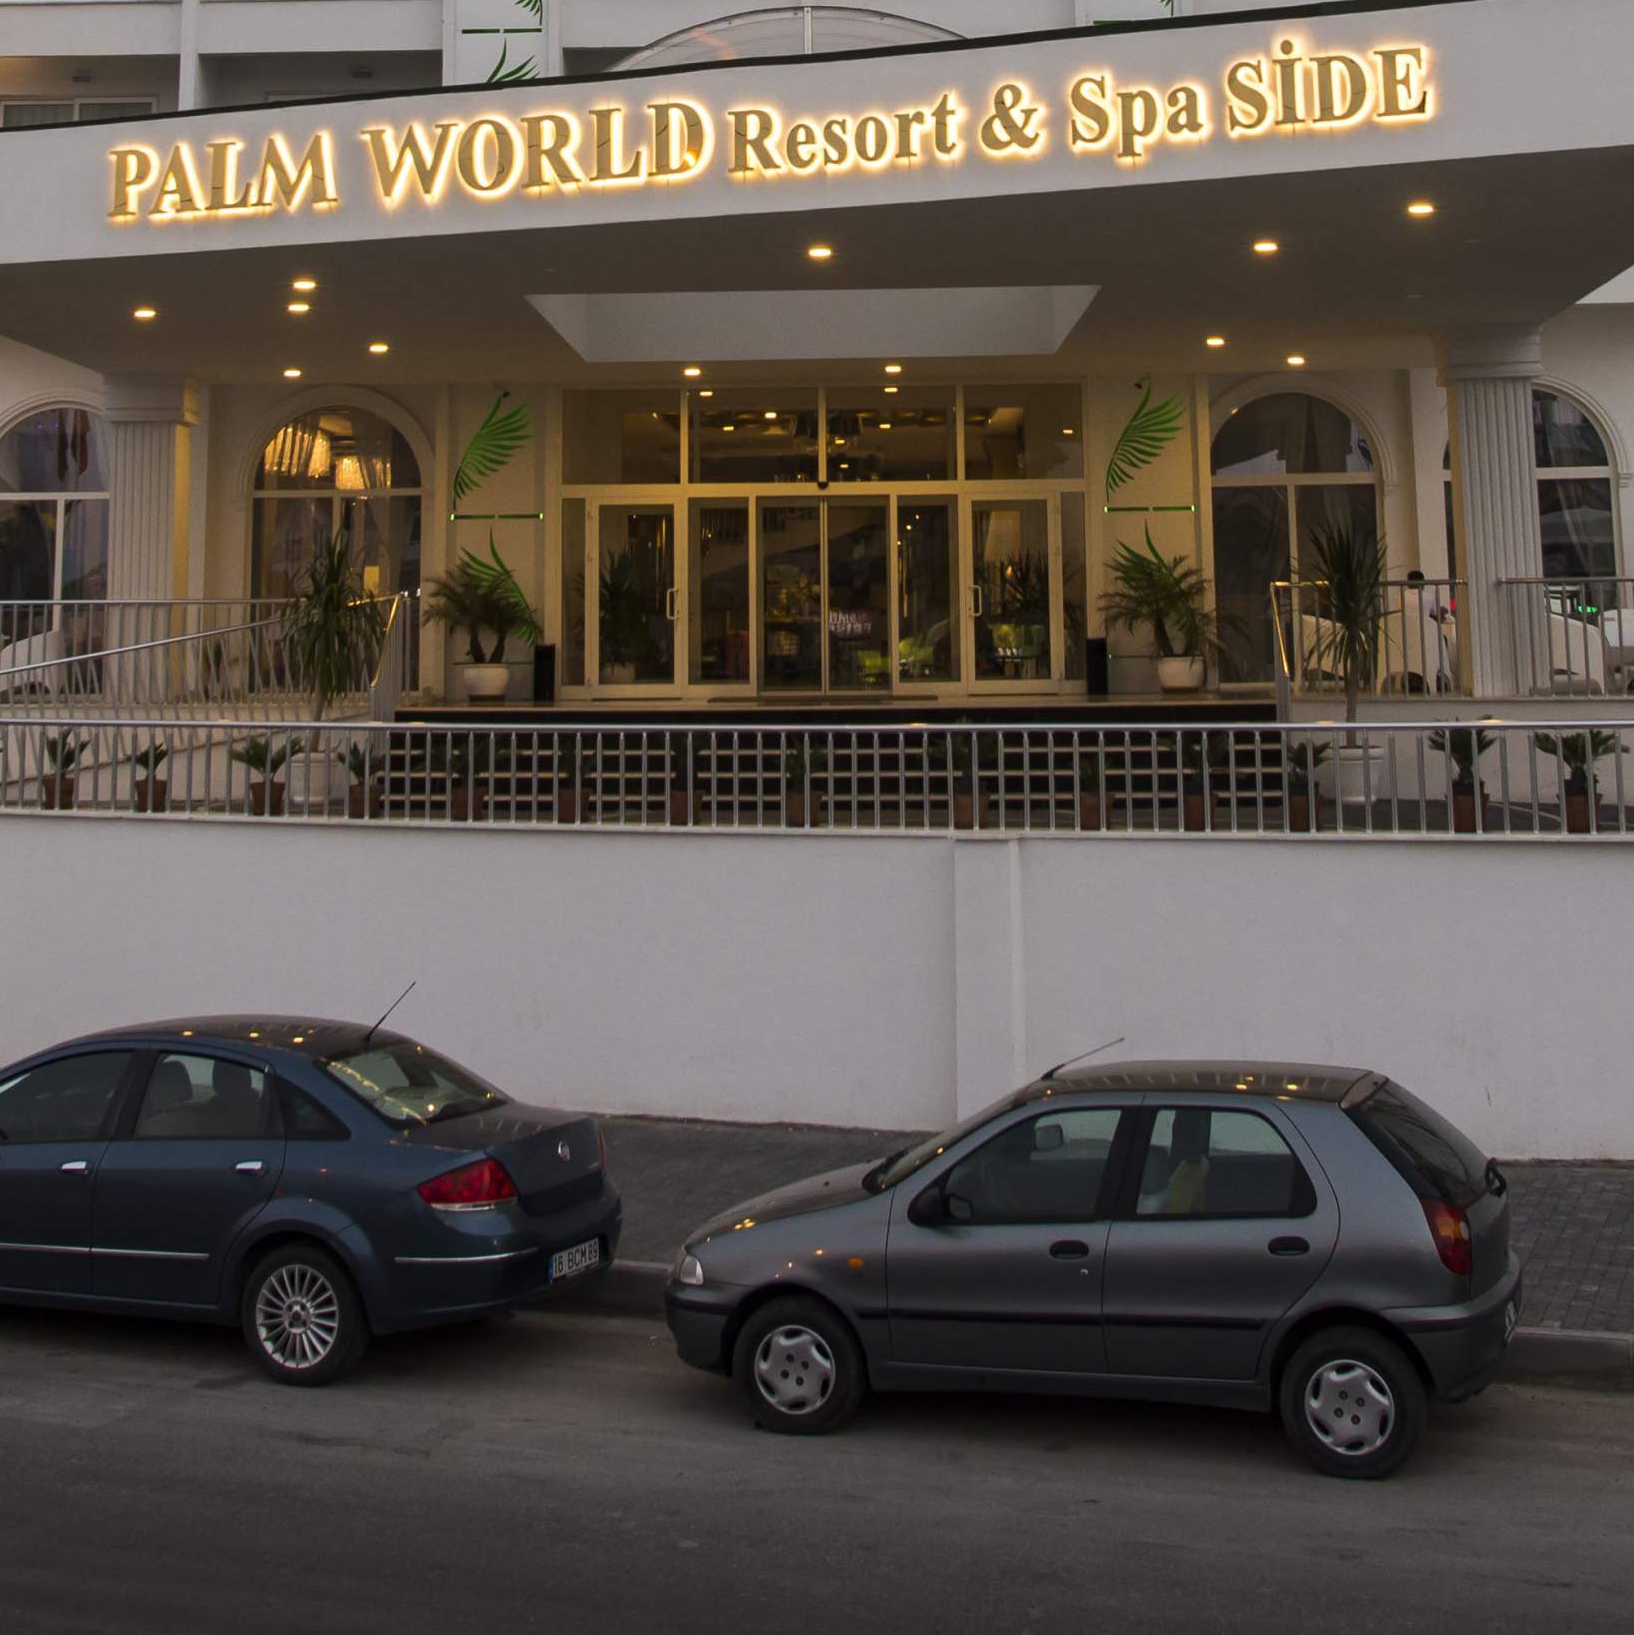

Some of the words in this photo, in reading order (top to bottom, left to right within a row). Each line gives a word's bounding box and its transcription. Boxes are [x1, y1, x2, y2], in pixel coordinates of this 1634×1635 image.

[110, 132, 338, 216] PALM
[362, 100, 706, 197] WORLD
[727, 94, 958, 174] Resort
[980, 83, 1041, 150] &
[1070, 75, 1204, 158] Spa
[1227, 40, 1432, 132] SİDE
[554, 1254, 564, 1275] 16
